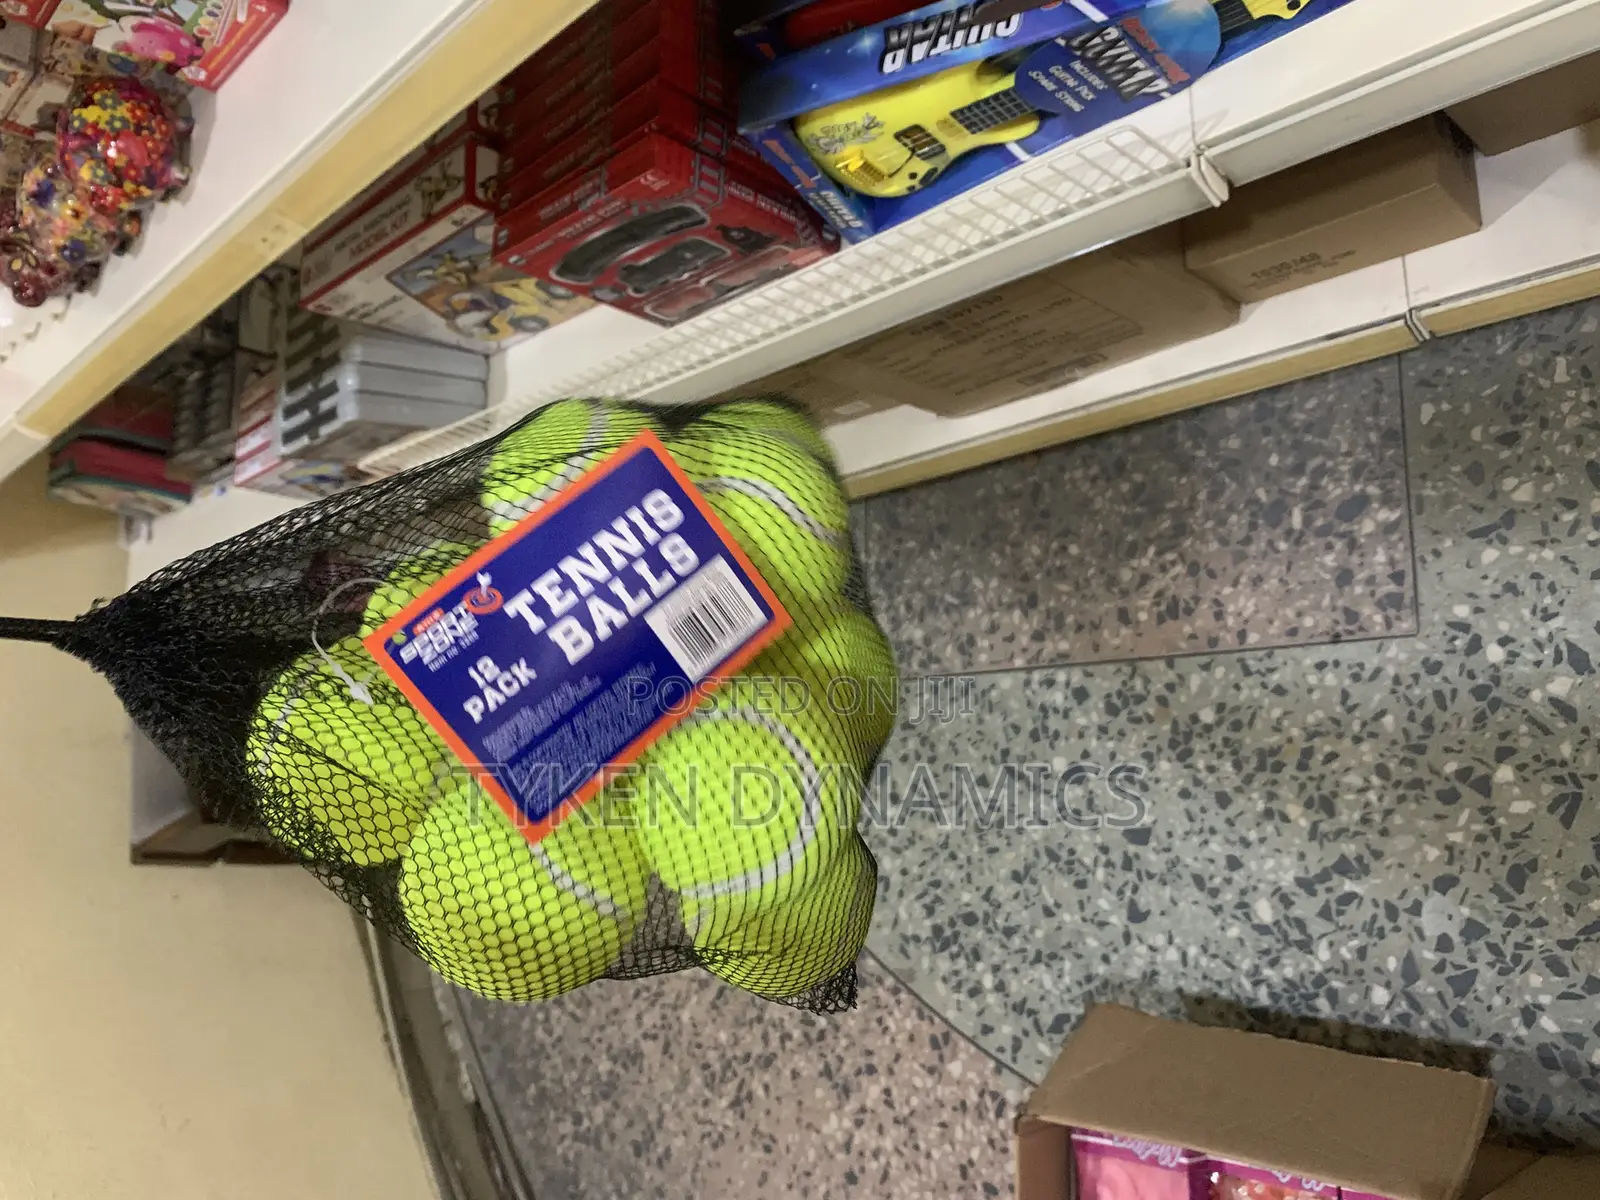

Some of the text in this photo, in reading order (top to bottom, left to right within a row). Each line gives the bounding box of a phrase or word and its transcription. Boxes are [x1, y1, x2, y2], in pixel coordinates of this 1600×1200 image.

[503, 488, 685, 635] TENNIS
[547, 532, 700, 666] BALLS
[462, 656, 538, 725] PACK
